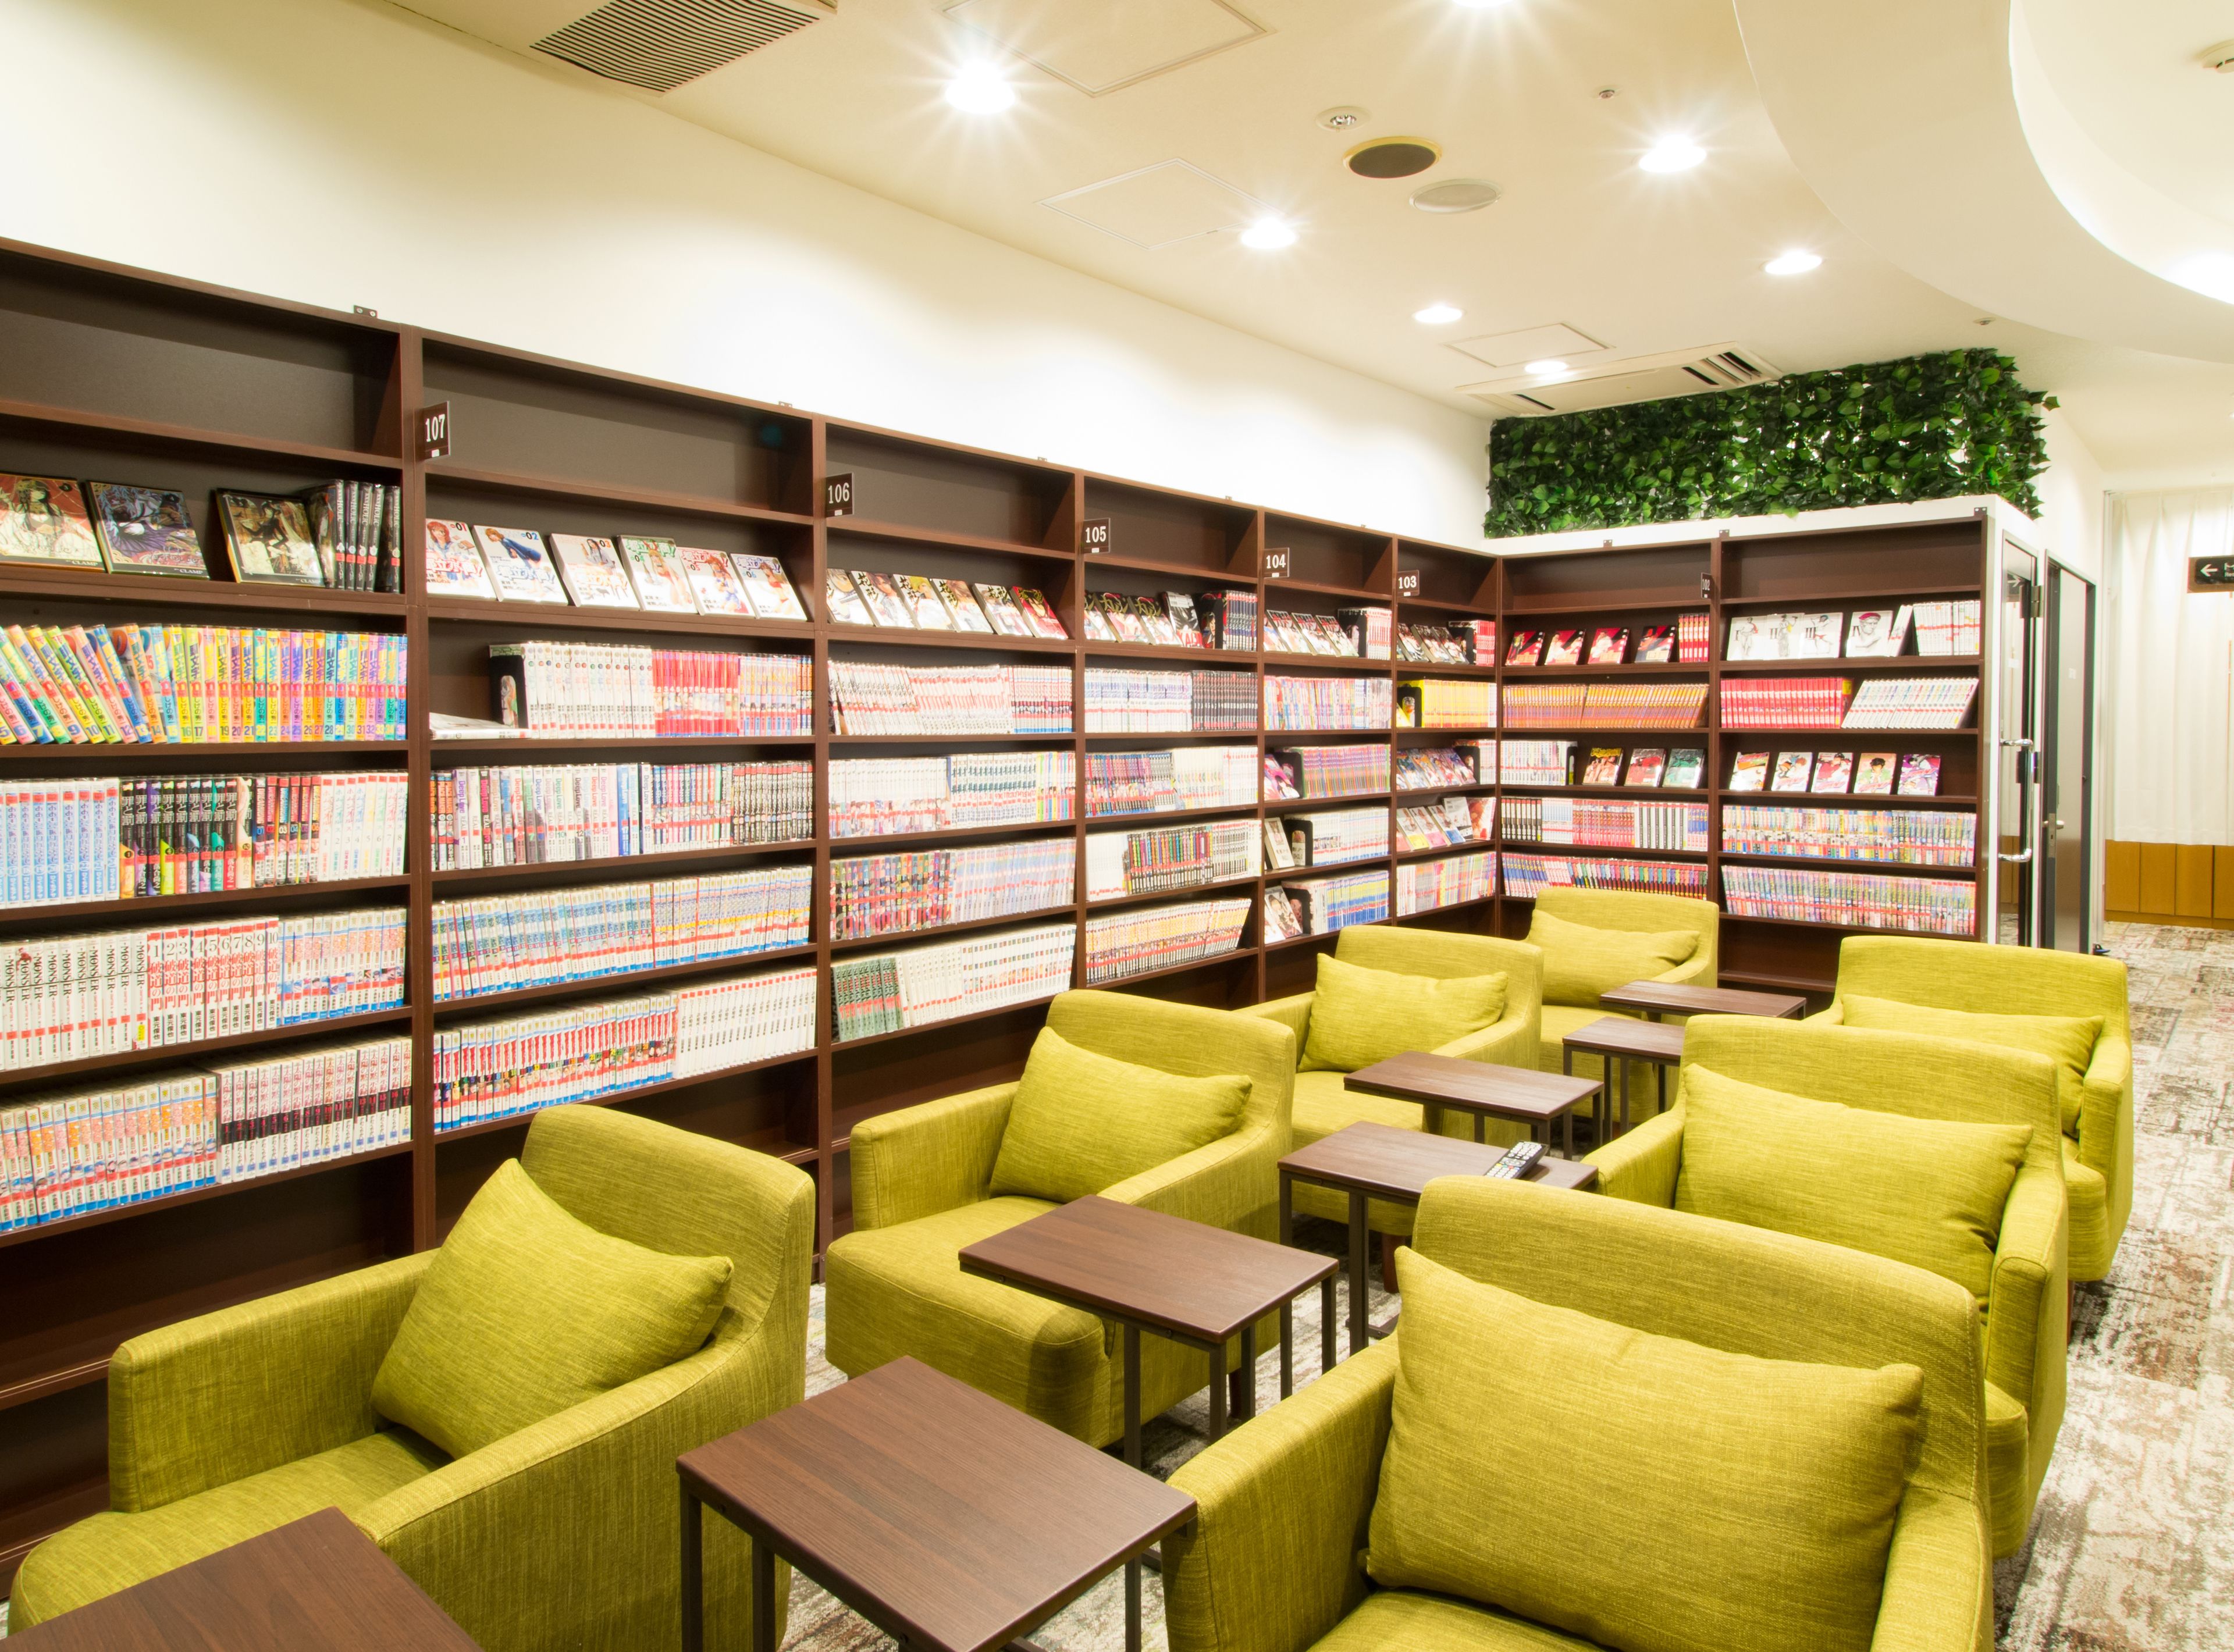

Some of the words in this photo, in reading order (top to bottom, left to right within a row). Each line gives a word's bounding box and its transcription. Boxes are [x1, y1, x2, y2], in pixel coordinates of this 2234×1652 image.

[425, 414, 446, 442] 107
[828, 482, 850, 504] 106
[456, 522, 467, 532] 01
[525, 532, 539, 540] 02
[1085, 526, 1107, 543] 105
[599, 539, 611, 548] 03
[1266, 554, 1286, 569] 104
[1398, 575, 1417, 589] 103
[1702, 579, 1710, 591] 102
[13, 725, 27, 736] 6
[31, 725, 43, 737] 7
[67, 724, 80, 735] 9
[86, 725, 99, 736] 10
[104, 725, 115, 736] 11
[120, 725, 132, 736] 12
[151, 725, 161, 736] 14
[182, 727, 191, 736] 16
[194, 727, 204, 736] 17
[220, 725, 229, 735] 19
[232, 725, 241, 736] 20
[244, 725, 255, 735] 21
[304, 725, 312, 735] 26
[315, 725, 323, 735] 27
[325, 725, 333, 735] 28
[357, 725, 365, 735] 31
[366, 725, 375, 734] 32
[234, 937, 241, 948] 7
[245, 935, 252, 948] 8
[257, 934, 265, 946] 9
[270, 932, 278, 944] 10
[167, 943, 174, 956] 2
[179, 942, 187, 955] 3
[195, 941, 204, 953] 4
[209, 940, 217, 952] 5
[222, 938, 229, 950] 6
[154, 945, 159, 957] 1
